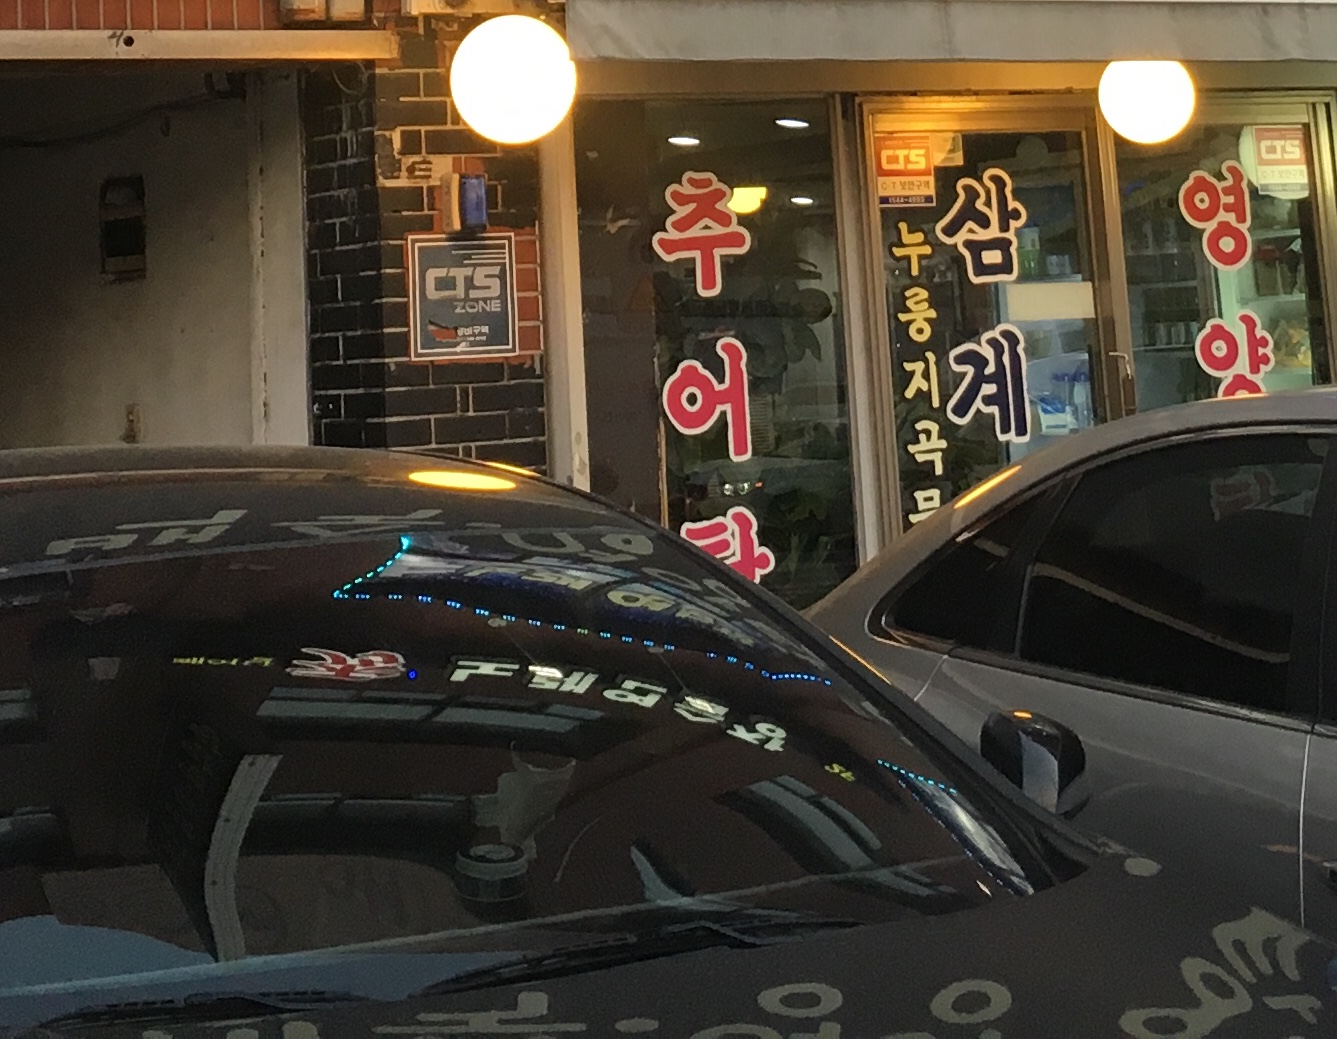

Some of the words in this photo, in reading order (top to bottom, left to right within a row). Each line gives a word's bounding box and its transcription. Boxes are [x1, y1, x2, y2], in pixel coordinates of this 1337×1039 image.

[880, 148, 927, 171] CTS
[1259, 139, 1302, 160] CTS
[424, 265, 502, 300] CTS
[453, 299, 502, 314] ZONE
